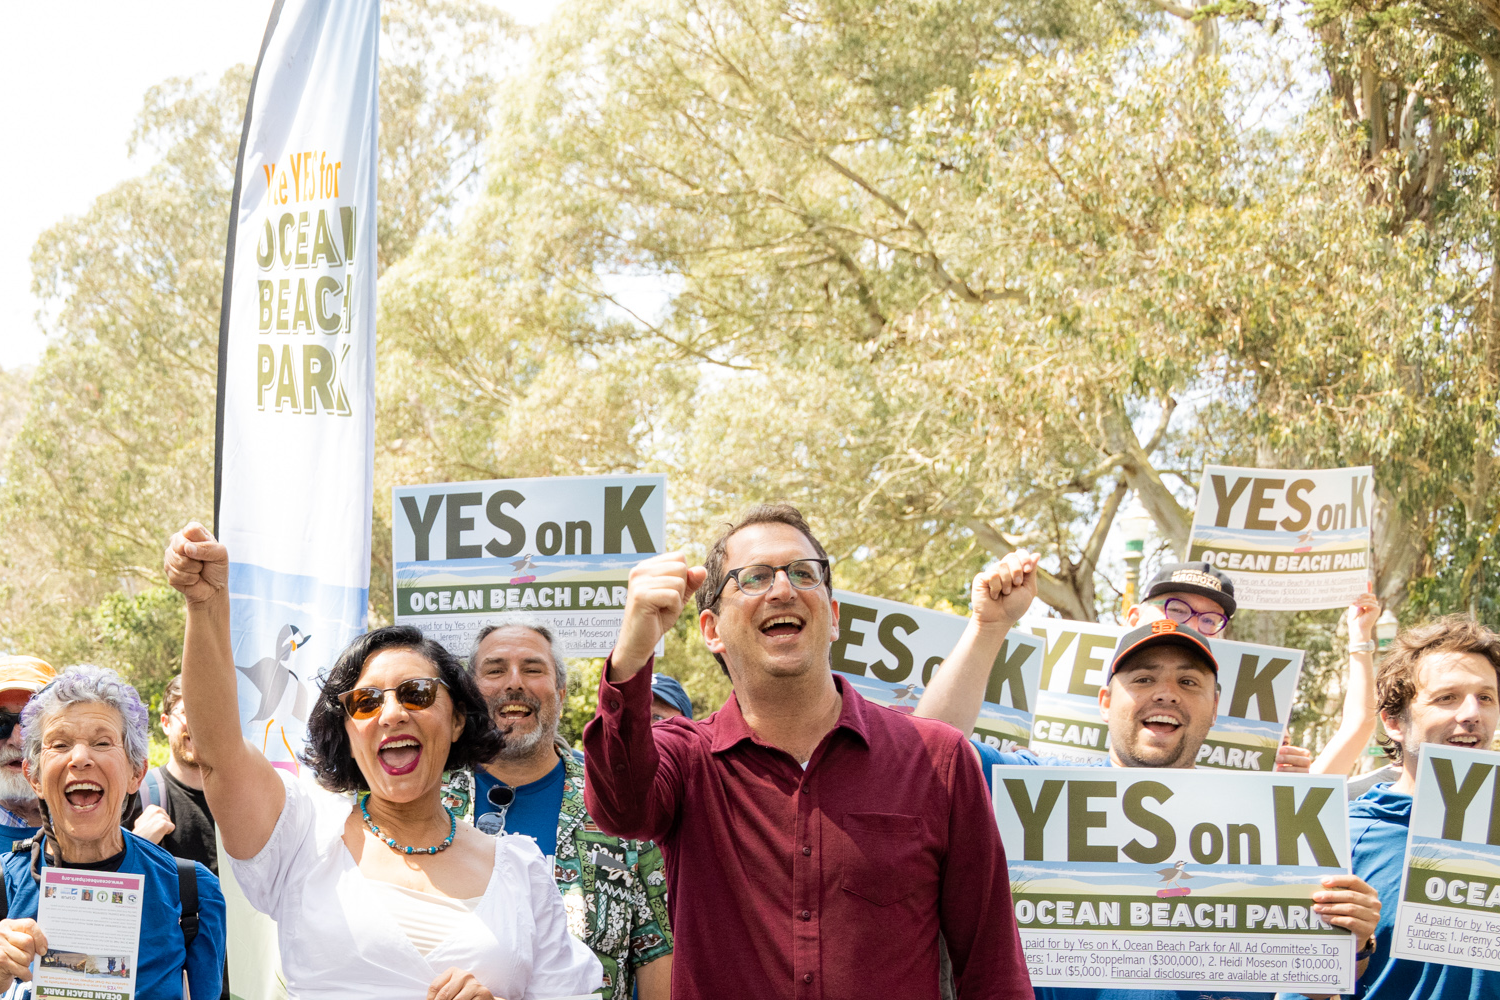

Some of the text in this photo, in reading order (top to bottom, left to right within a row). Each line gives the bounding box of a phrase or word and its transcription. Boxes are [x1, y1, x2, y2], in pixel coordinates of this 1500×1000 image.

[320, 151, 342, 199] for
[1210, 474, 1368, 532] YES on K
[399, 485, 656, 561] YES on K
[1275, 551, 1331, 572] BEACH
[1333, 551, 1366, 569] PARK
[410, 590, 484, 612] OCEAN
[490, 586, 571, 609] BEACH
[454, 620, 466, 629] Yes
[984, 638, 1037, 713] K
[1229, 653, 1292, 723] K
[1196, 743, 1263, 770] PARK
[1002, 778, 1177, 865] YES
[1189, 822, 1262, 866] on
[1272, 785, 1341, 868] K
[1015, 900, 1120, 926] OCEAN
[1130, 901, 1235, 928] BEACH
[1414, 912, 1428, 923] Ad
[1431, 915, 1452, 926] paid
[1454, 917, 1467, 928] for
[1470, 919, 1482, 932] by
[1406, 925, 1448, 941] Funders:
[1459, 932, 1493, 948] Jeremy
[1407, 938, 1416, 949] 3.
[1418, 939, 1445, 952] Lucas
[1448, 943, 1465, 955] Lux
[43, 987, 122, 1000] OCEAN BEACH PARK
